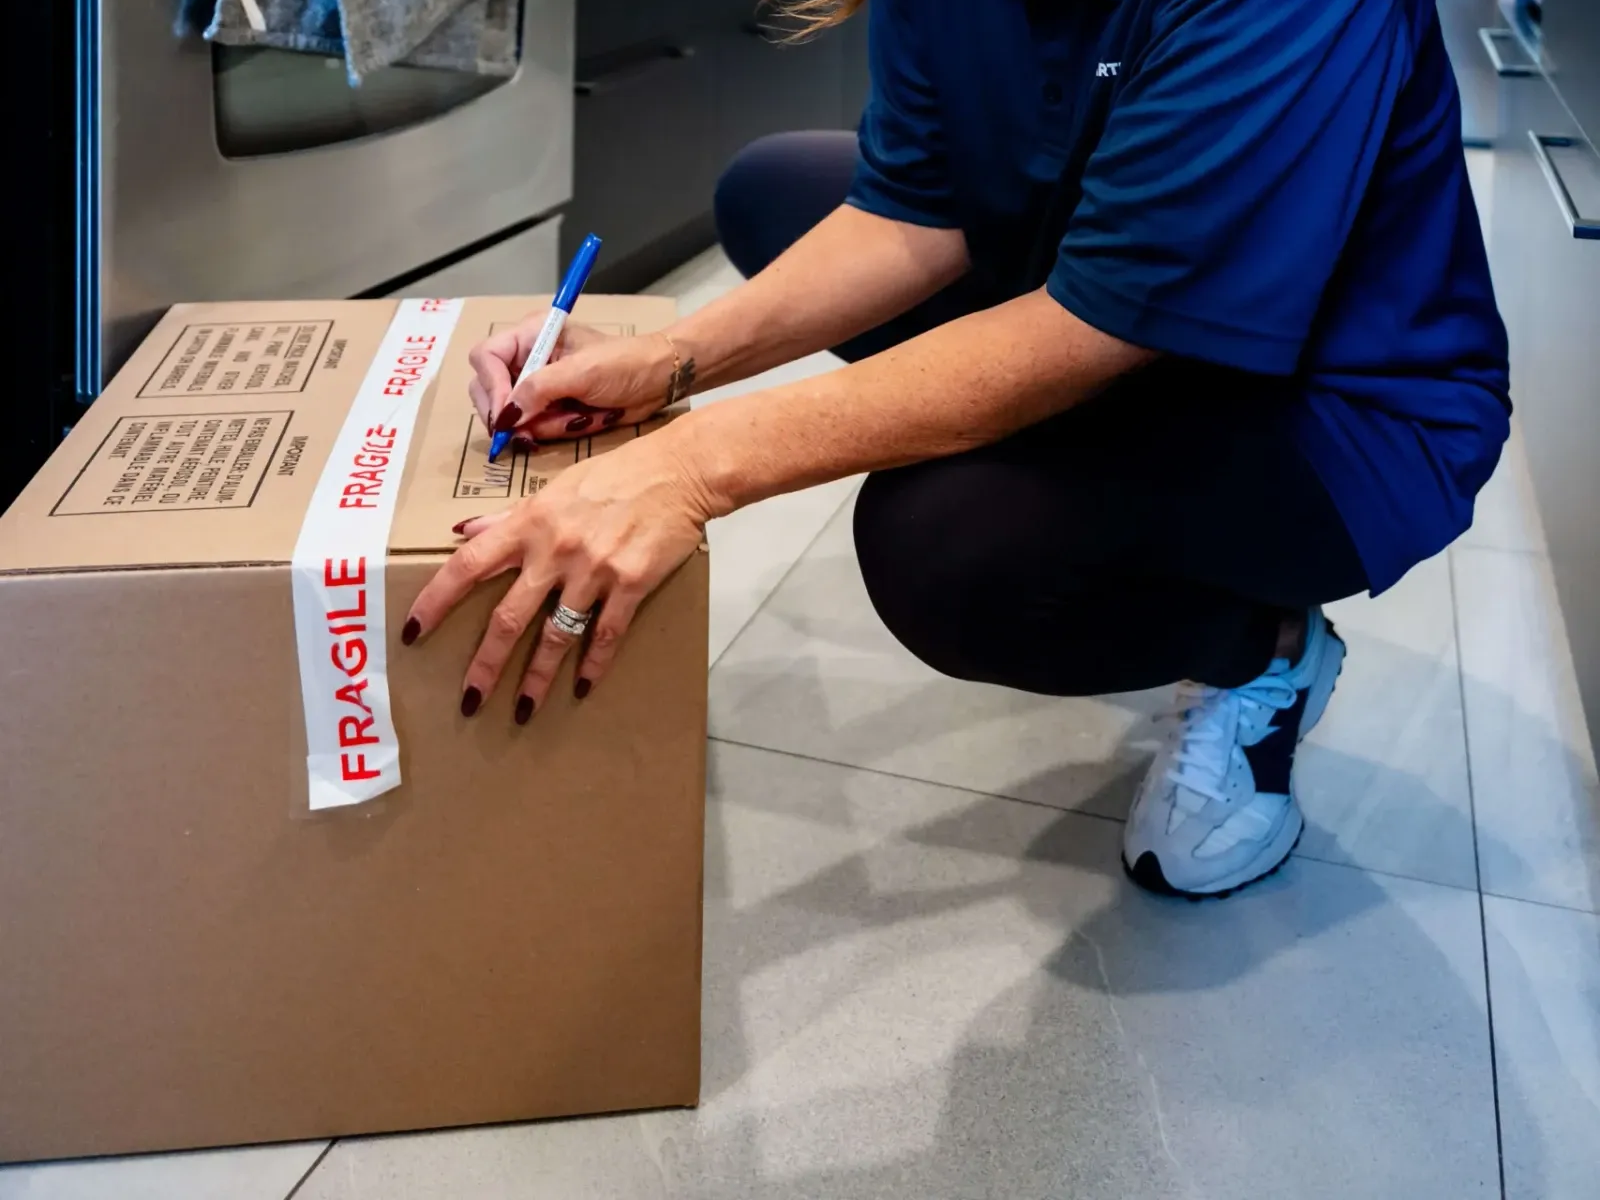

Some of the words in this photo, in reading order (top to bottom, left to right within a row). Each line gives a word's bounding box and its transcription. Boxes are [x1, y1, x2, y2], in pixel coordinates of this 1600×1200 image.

[383, 335, 436, 396] FRAGILE
[174, 419, 199, 438] TOUT
[248, 426, 268, 438] PAS
[254, 416, 272, 426] NE
[127, 420, 174, 471] INFLAMMABLE
[187, 418, 223, 456] CONTENANT
[157, 440, 186, 464] AUTRE
[339, 424, 398, 509] FRAGILE
[112, 471, 141, 493] DANS
[103, 494, 126, 506] CE
[160, 492, 181, 504] OU
[325, 556, 381, 782] FRAGILE
